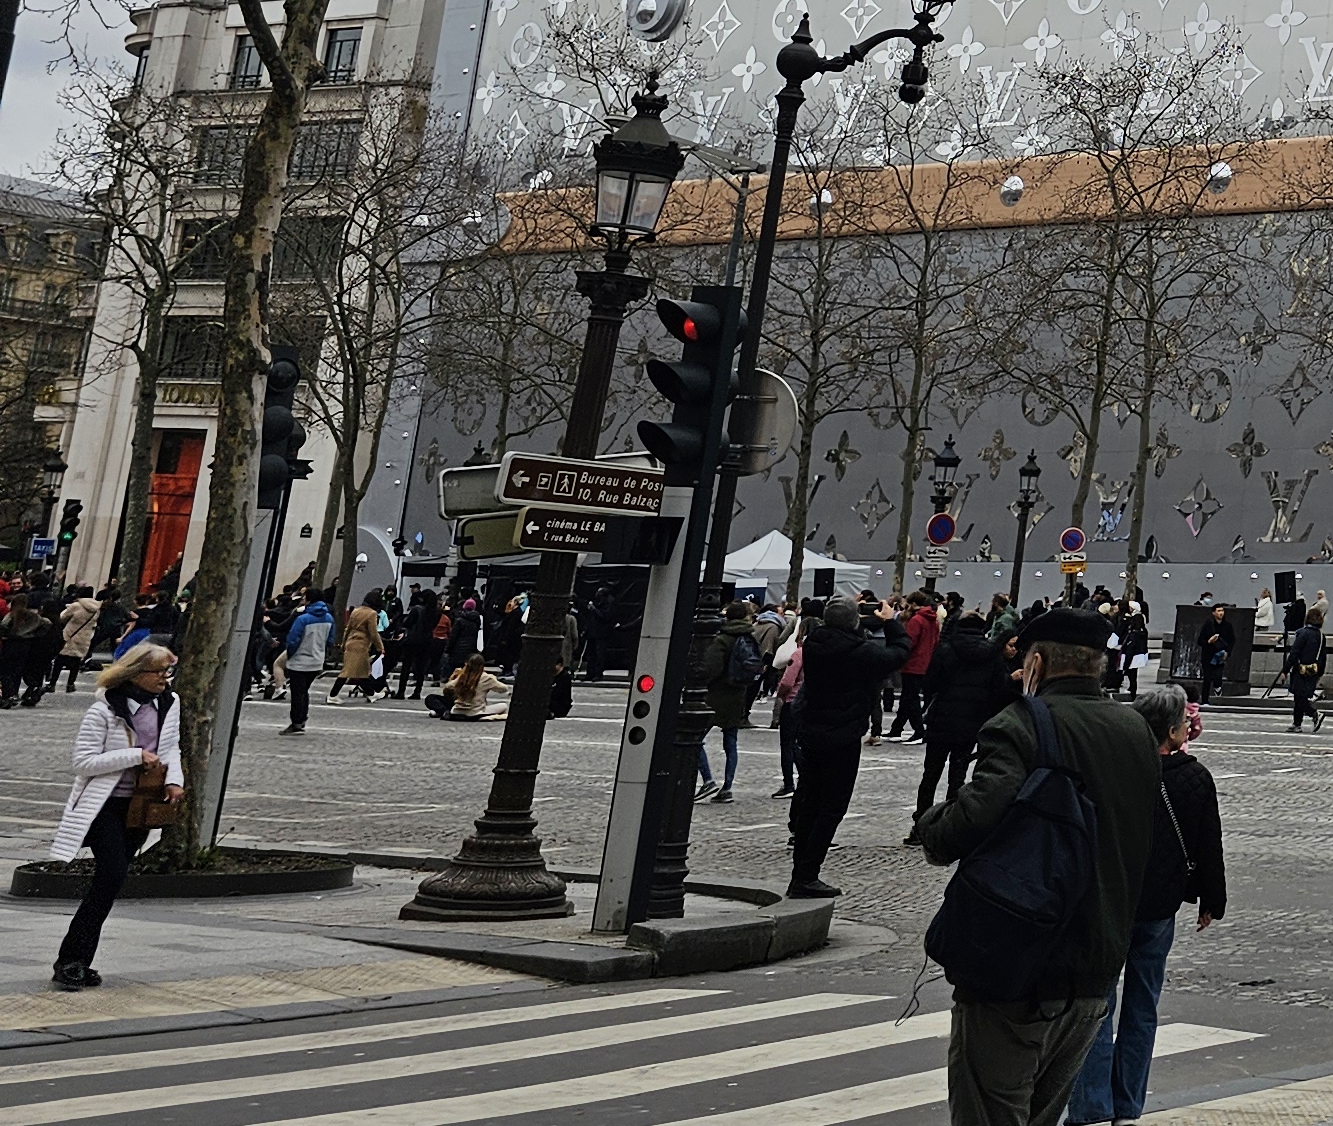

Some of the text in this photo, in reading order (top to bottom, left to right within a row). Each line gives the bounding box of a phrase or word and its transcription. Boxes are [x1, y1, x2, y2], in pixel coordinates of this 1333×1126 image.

[579, 471, 620, 488] Bureau
[623, 476, 638, 489] de
[577, 488, 660, 508] 10, Rue Balzac
[546, 517, 579, 531] cinéma
[580, 520, 591, 531] LE
[550, 534, 563, 543] rue
[564, 533, 589, 544] Balzac
